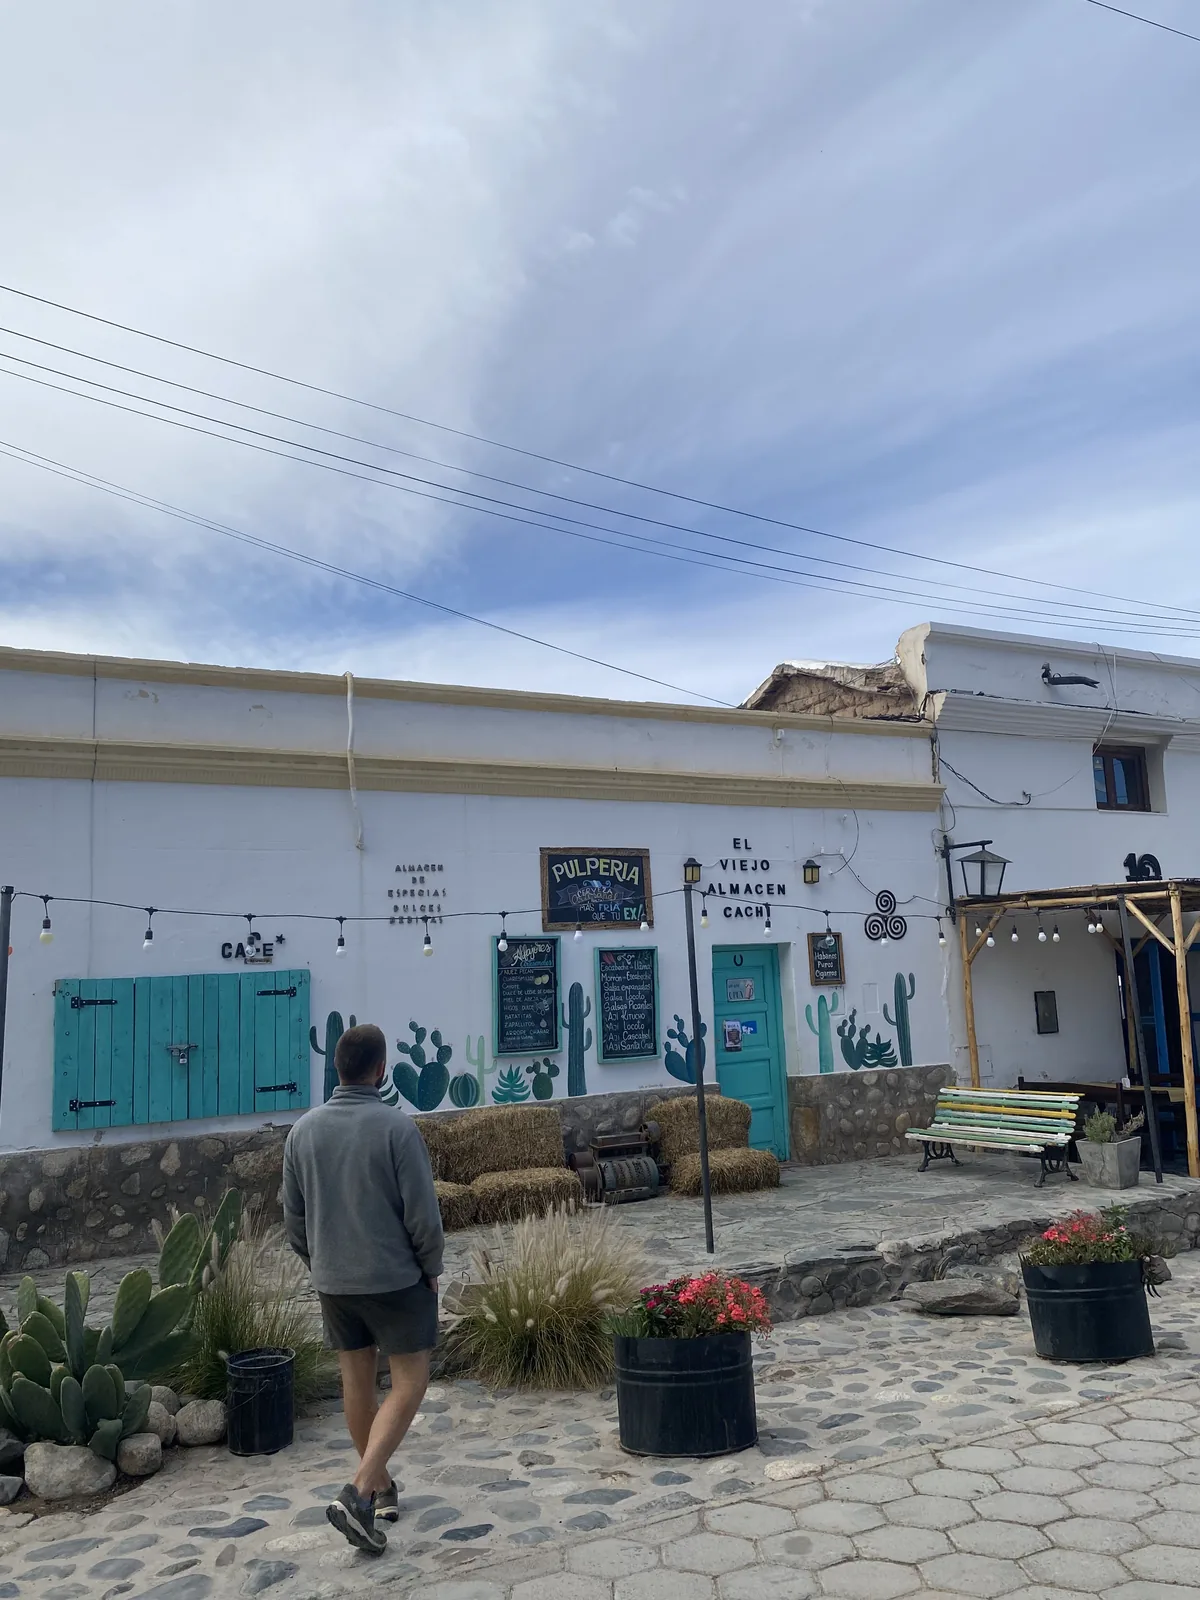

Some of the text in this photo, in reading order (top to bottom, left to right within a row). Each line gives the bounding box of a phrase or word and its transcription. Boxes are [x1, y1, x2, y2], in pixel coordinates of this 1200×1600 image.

[733, 838, 752, 850] EL
[395, 864, 444, 873] ALMACEN
[720, 859, 770, 871] VIEJO
[551, 857, 639, 886] PULPERIA
[411, 875, 426, 885] DE
[387, 888, 447, 898] ESPECIAS
[577, 886, 613, 898] CERVEZA
[707, 882, 786, 896] ALMACEN
[393, 904, 442, 913] DULCES
[579, 901, 621, 912] MÁS FRÍA
[592, 912, 606, 922] QUE
[611, 912, 621, 920] TU
[723, 906, 771, 918] CACHI
[389, 916, 443, 925] BEBIAS
[510, 942, 552, 966] Alfajores
[814, 951, 837, 960] Habanos
[817, 961, 834, 969] Puros
[815, 969, 837, 980] Cigarros
[603, 981, 620, 991] Salsa
[603, 991, 623, 1001] Salsa
[603, 1001, 628, 1012] Salsas
